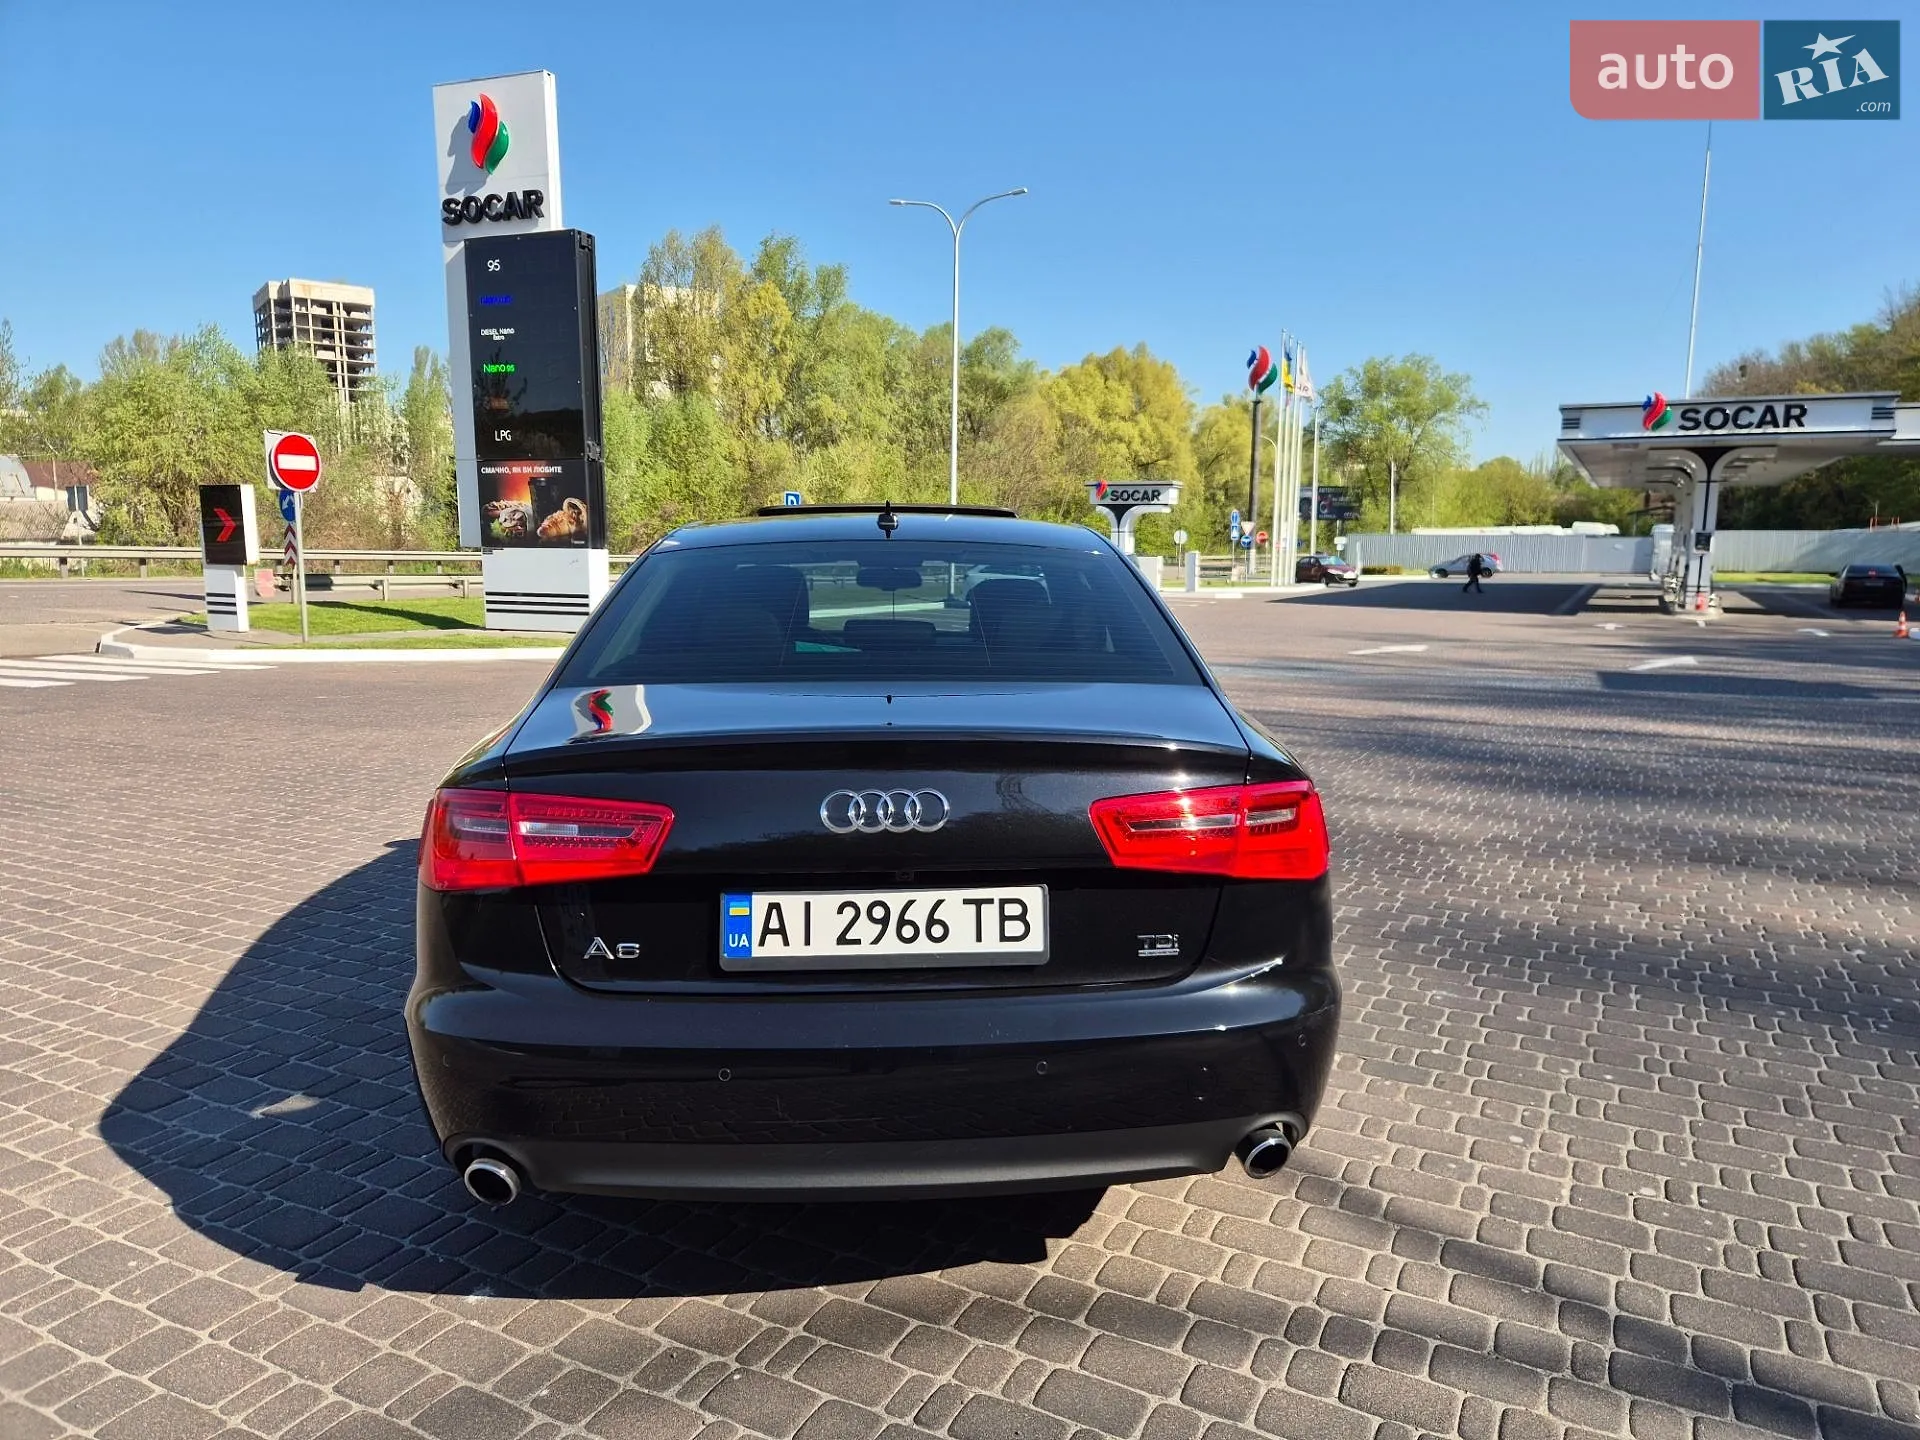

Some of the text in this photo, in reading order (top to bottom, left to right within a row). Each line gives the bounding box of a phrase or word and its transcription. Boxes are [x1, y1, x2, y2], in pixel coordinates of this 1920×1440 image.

[441, 189, 545, 226] SOCAR
[487, 259, 501, 272] 95
[483, 363, 506, 373] Nano
[1678, 404, 1808, 431] SOCAR
[494, 429, 512, 442] LPG
[1110, 489, 1162, 502] SOCAR
[758, 898, 1031, 947] AI 2966 TB
[729, 933, 750, 948] UA
[583, 937, 640, 960] A6
